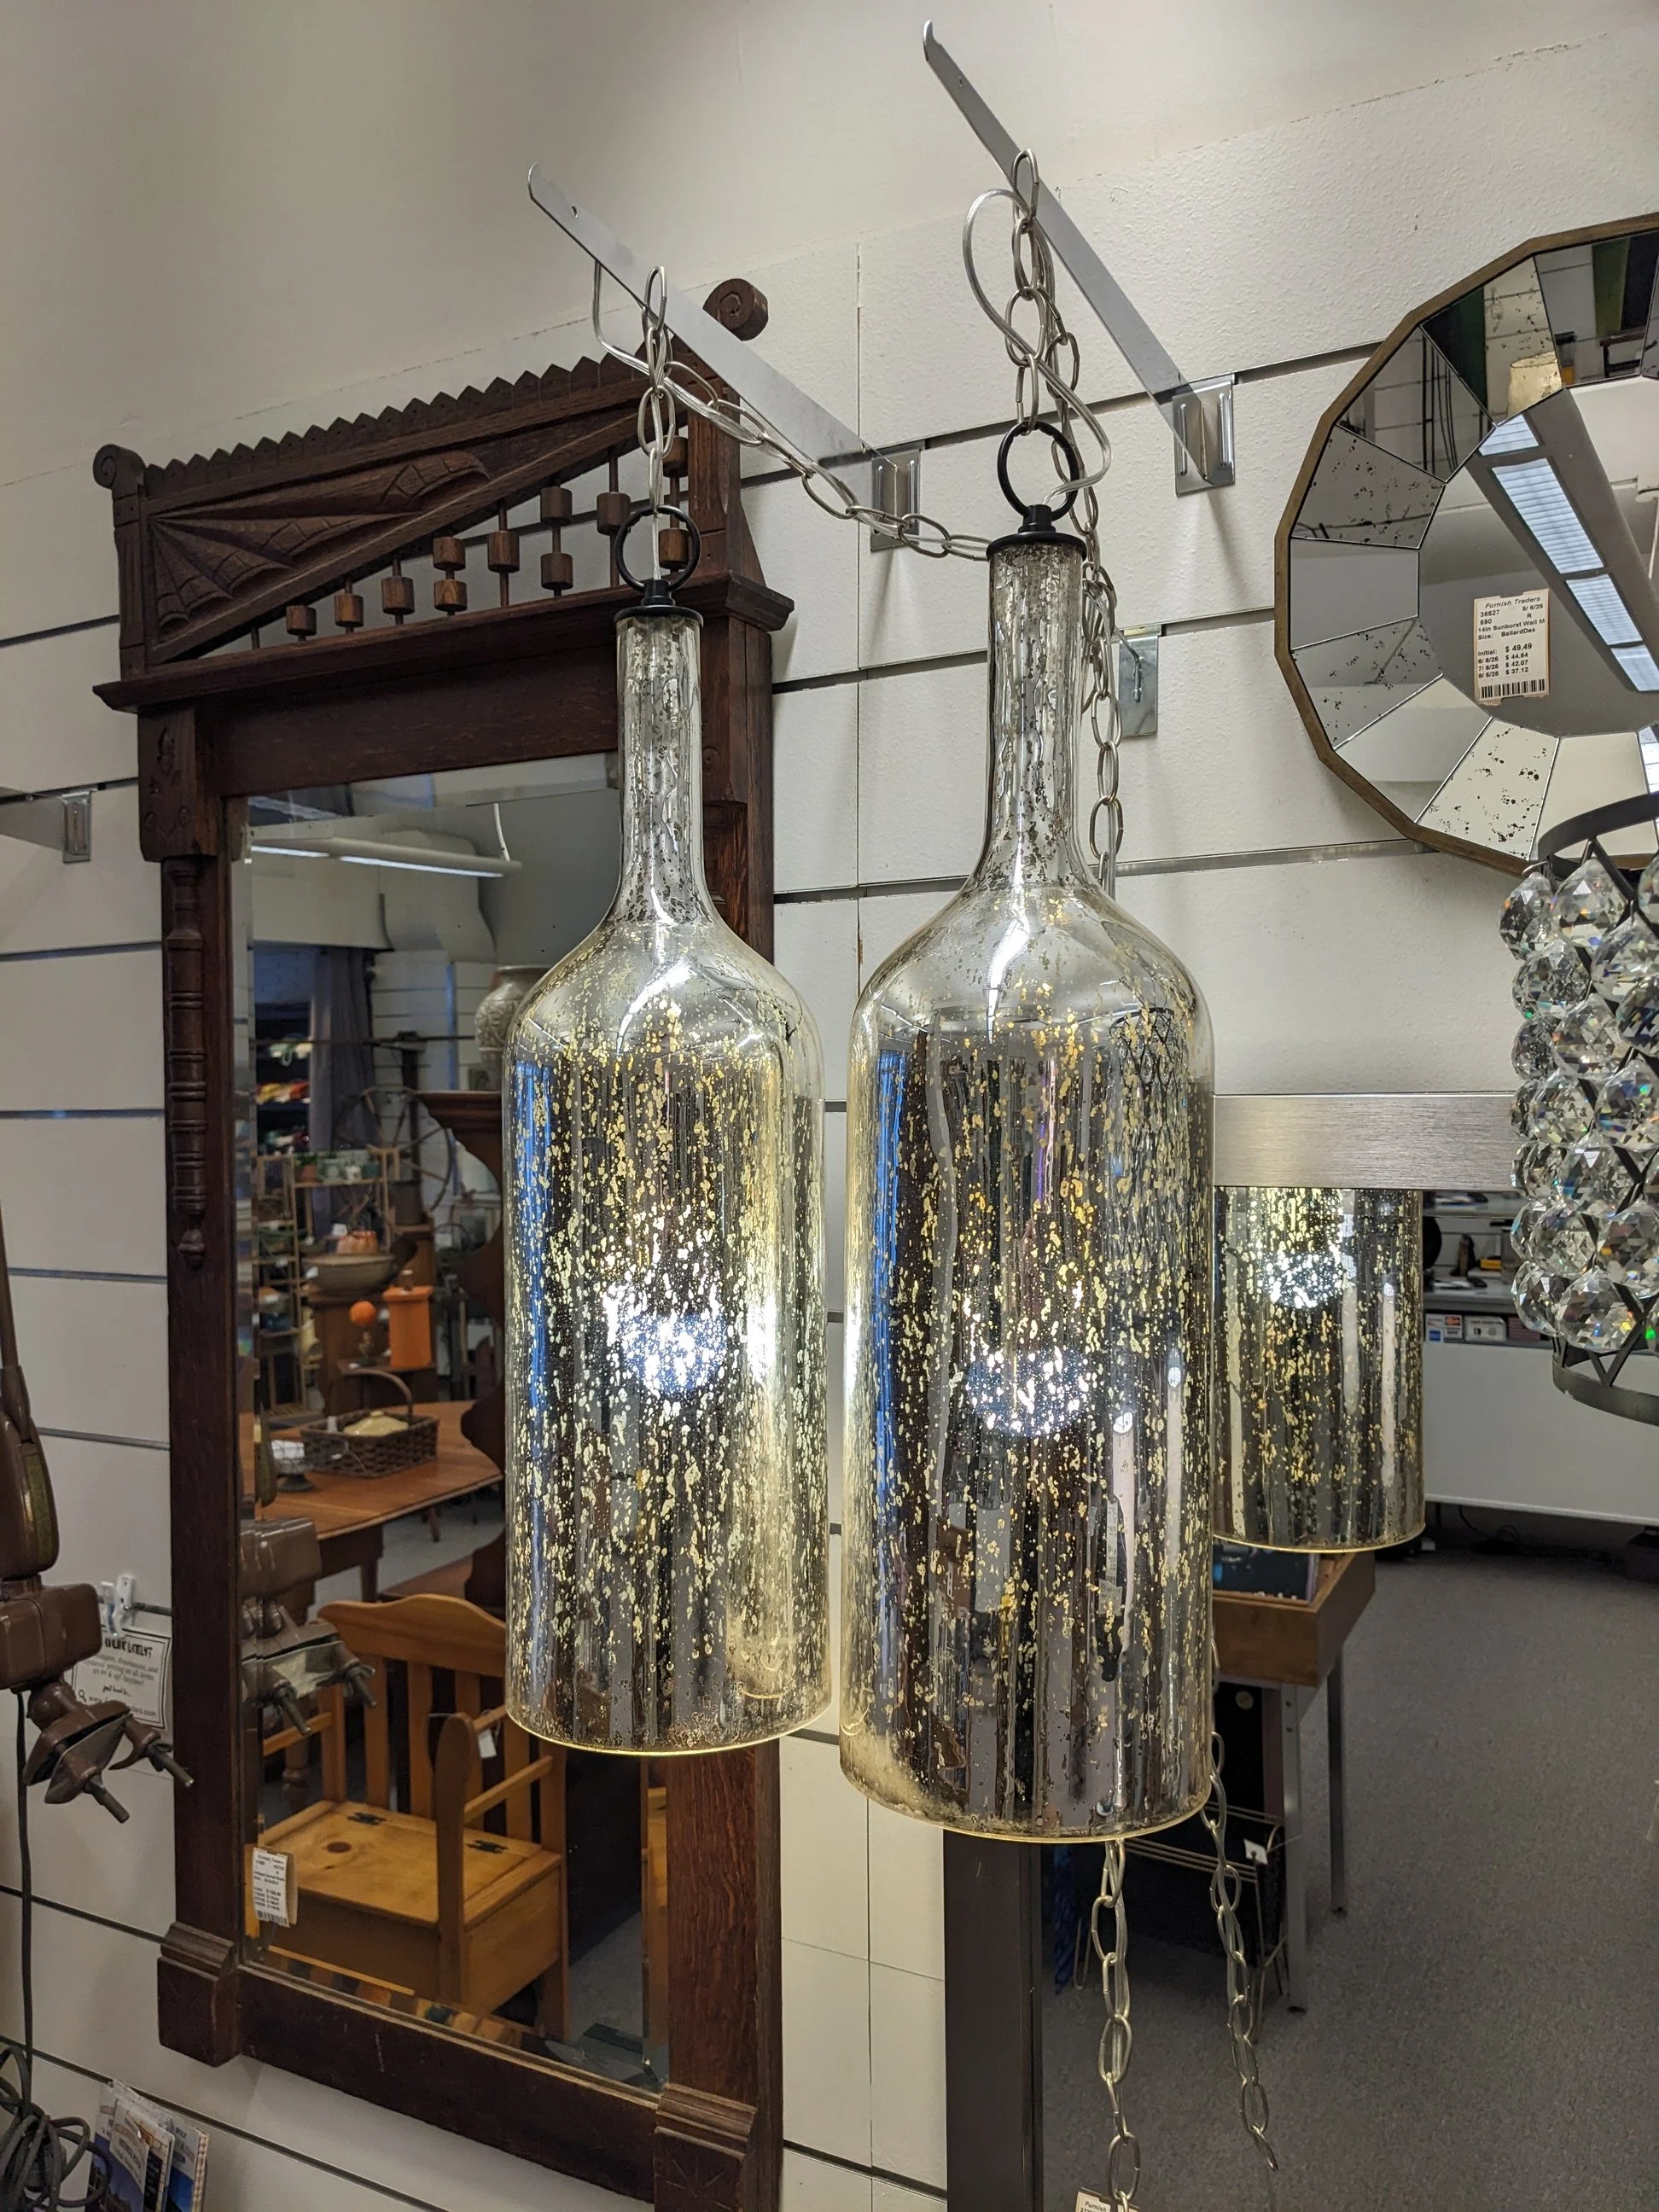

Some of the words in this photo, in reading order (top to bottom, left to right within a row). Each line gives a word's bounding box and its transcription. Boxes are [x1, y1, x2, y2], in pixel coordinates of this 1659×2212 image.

[1485, 600, 1511, 608] Furnish
[1493, 622, 1522, 631] Sunburst
[1501, 628, 1535, 637] BallardDes
[1511, 643, 1532, 651] 49.49
